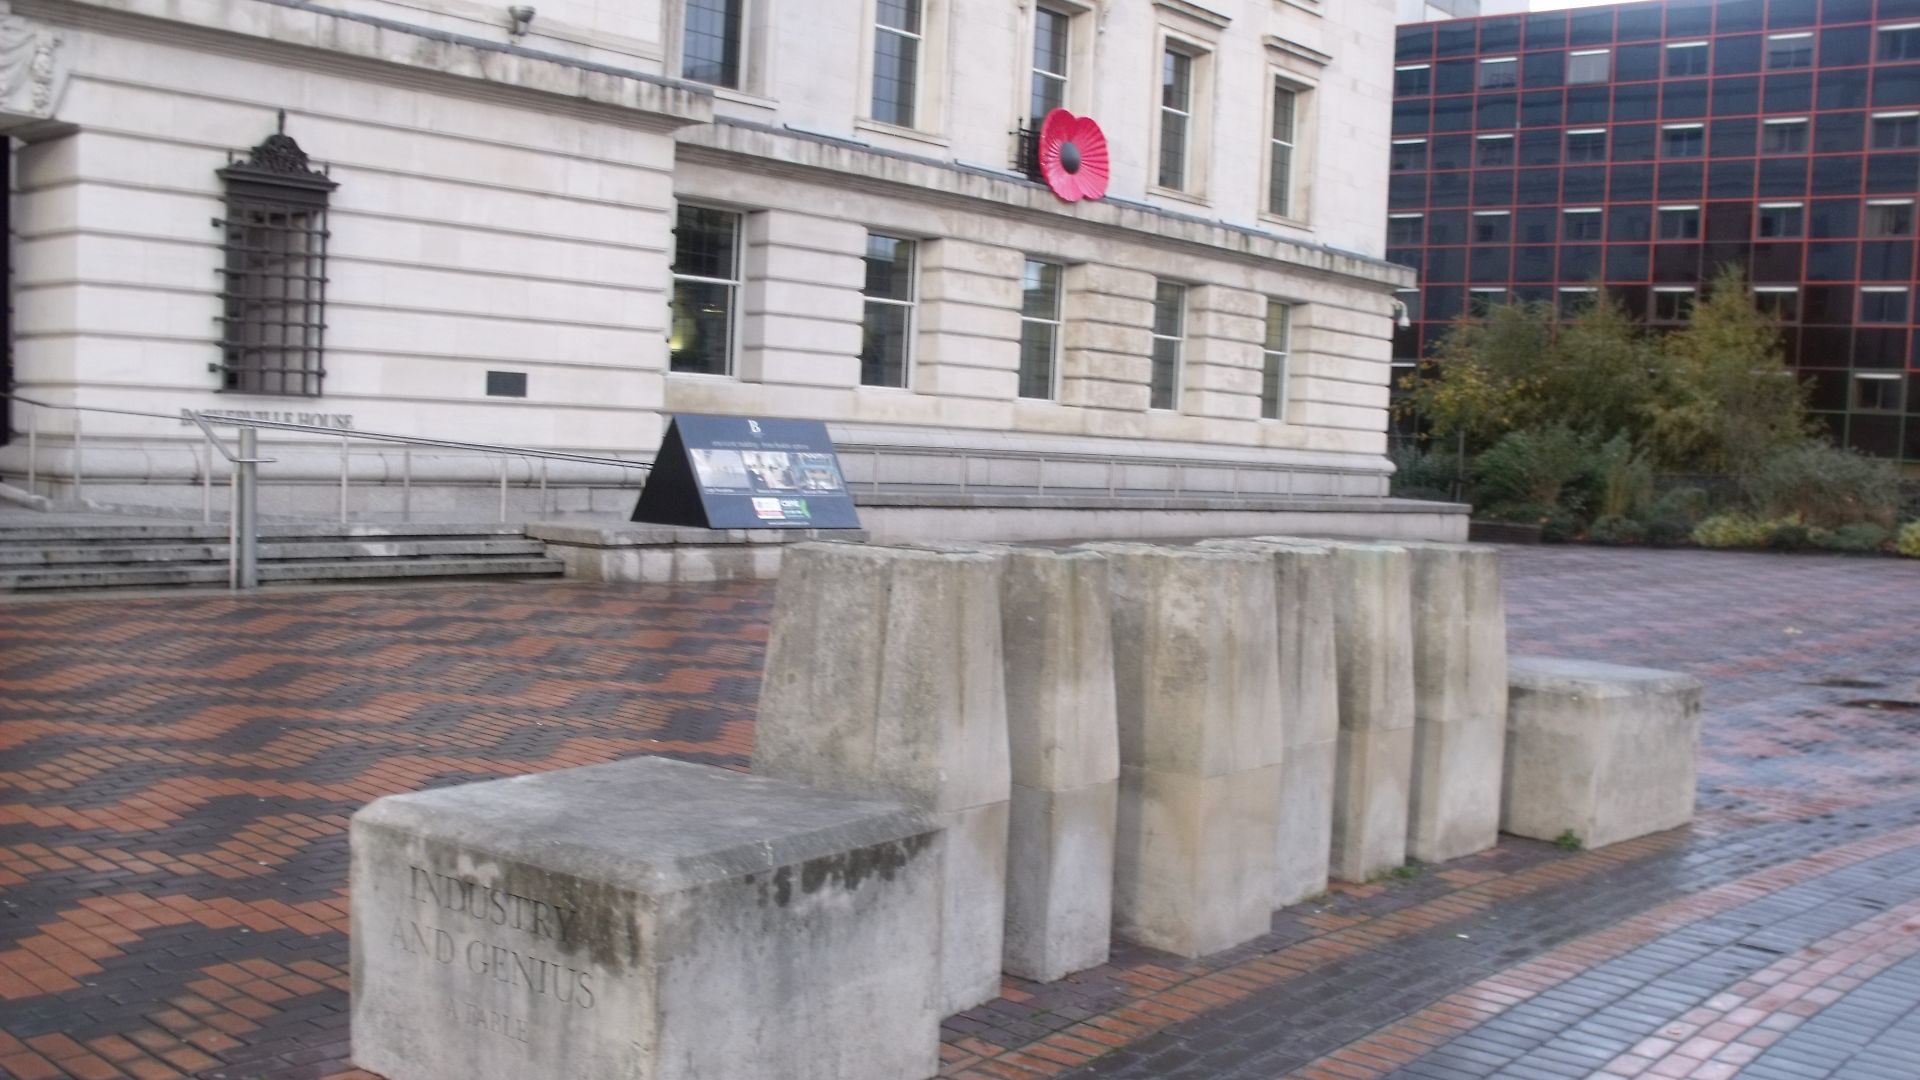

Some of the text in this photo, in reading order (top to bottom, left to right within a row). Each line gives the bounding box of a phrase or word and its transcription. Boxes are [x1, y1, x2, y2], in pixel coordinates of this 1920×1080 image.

[409, 865, 577, 943] INDUSTRY
[390, 916, 596, 1009] AND GENIUS
